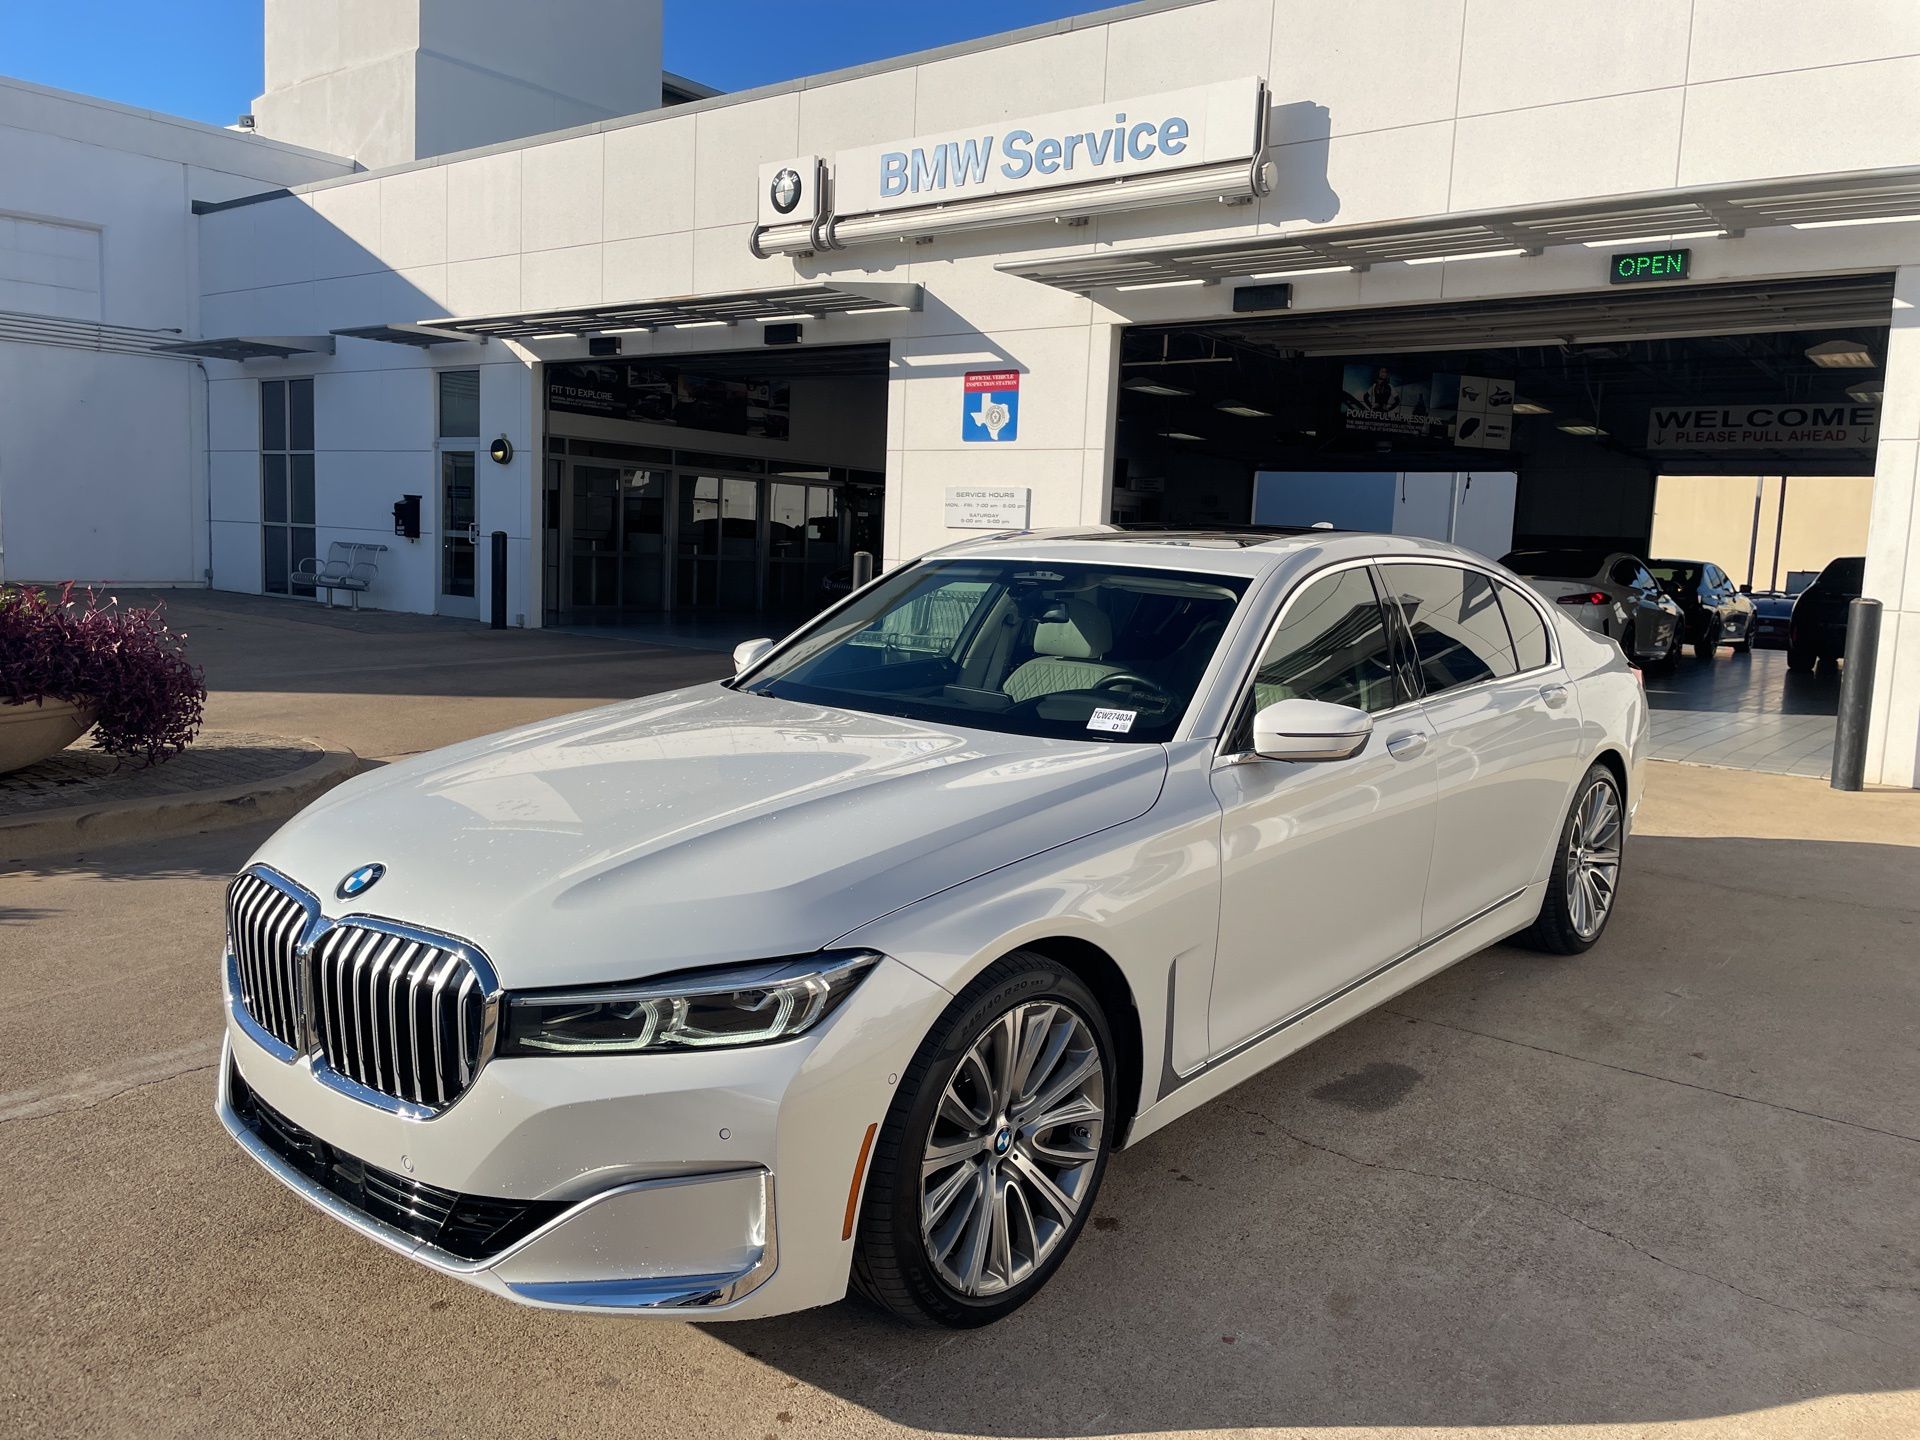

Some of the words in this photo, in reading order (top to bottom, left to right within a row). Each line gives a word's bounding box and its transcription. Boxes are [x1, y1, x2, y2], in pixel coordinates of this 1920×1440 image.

[880, 136, 994, 198] BMW
[1000, 112, 1190, 180] Service
[1619, 254, 1682, 277] OPEN
[551, 384, 563, 394] FIT
[565, 386, 577, 396] TO
[1346, 408, 1391, 421] POWERFUL
[1655, 407, 1876, 429] WELCOME
[1675, 431, 1737, 443] PLEASE
[1742, 430, 1784, 442] PULL
[1787, 429, 1848, 442] AHEAD
[1004, 980, 1028, 998] R20
